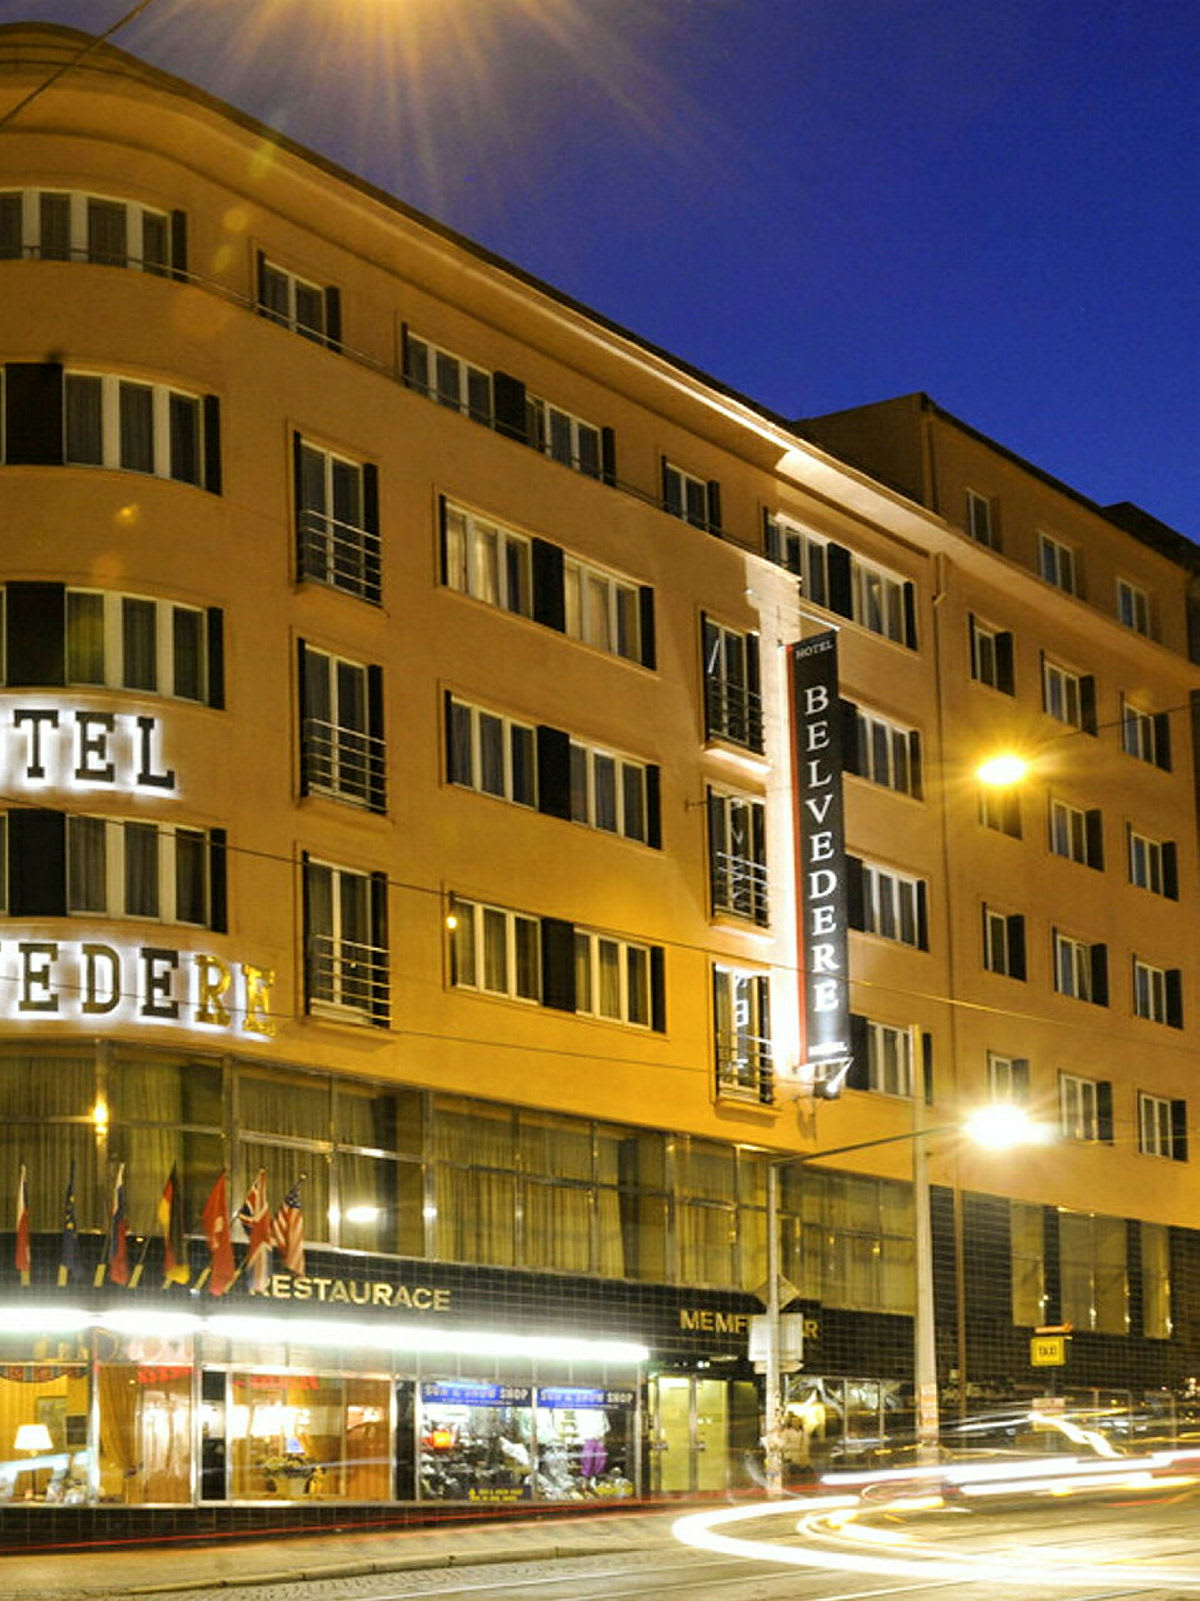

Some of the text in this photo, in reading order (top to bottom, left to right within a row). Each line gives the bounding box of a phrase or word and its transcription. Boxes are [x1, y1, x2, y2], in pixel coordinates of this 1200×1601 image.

[796, 640, 833, 659] HOTEL
[805, 684, 838, 1012] BELVEDERE
[500, 1388, 529, 1400] SHOP
[607, 1392, 634, 1403] SHOP
